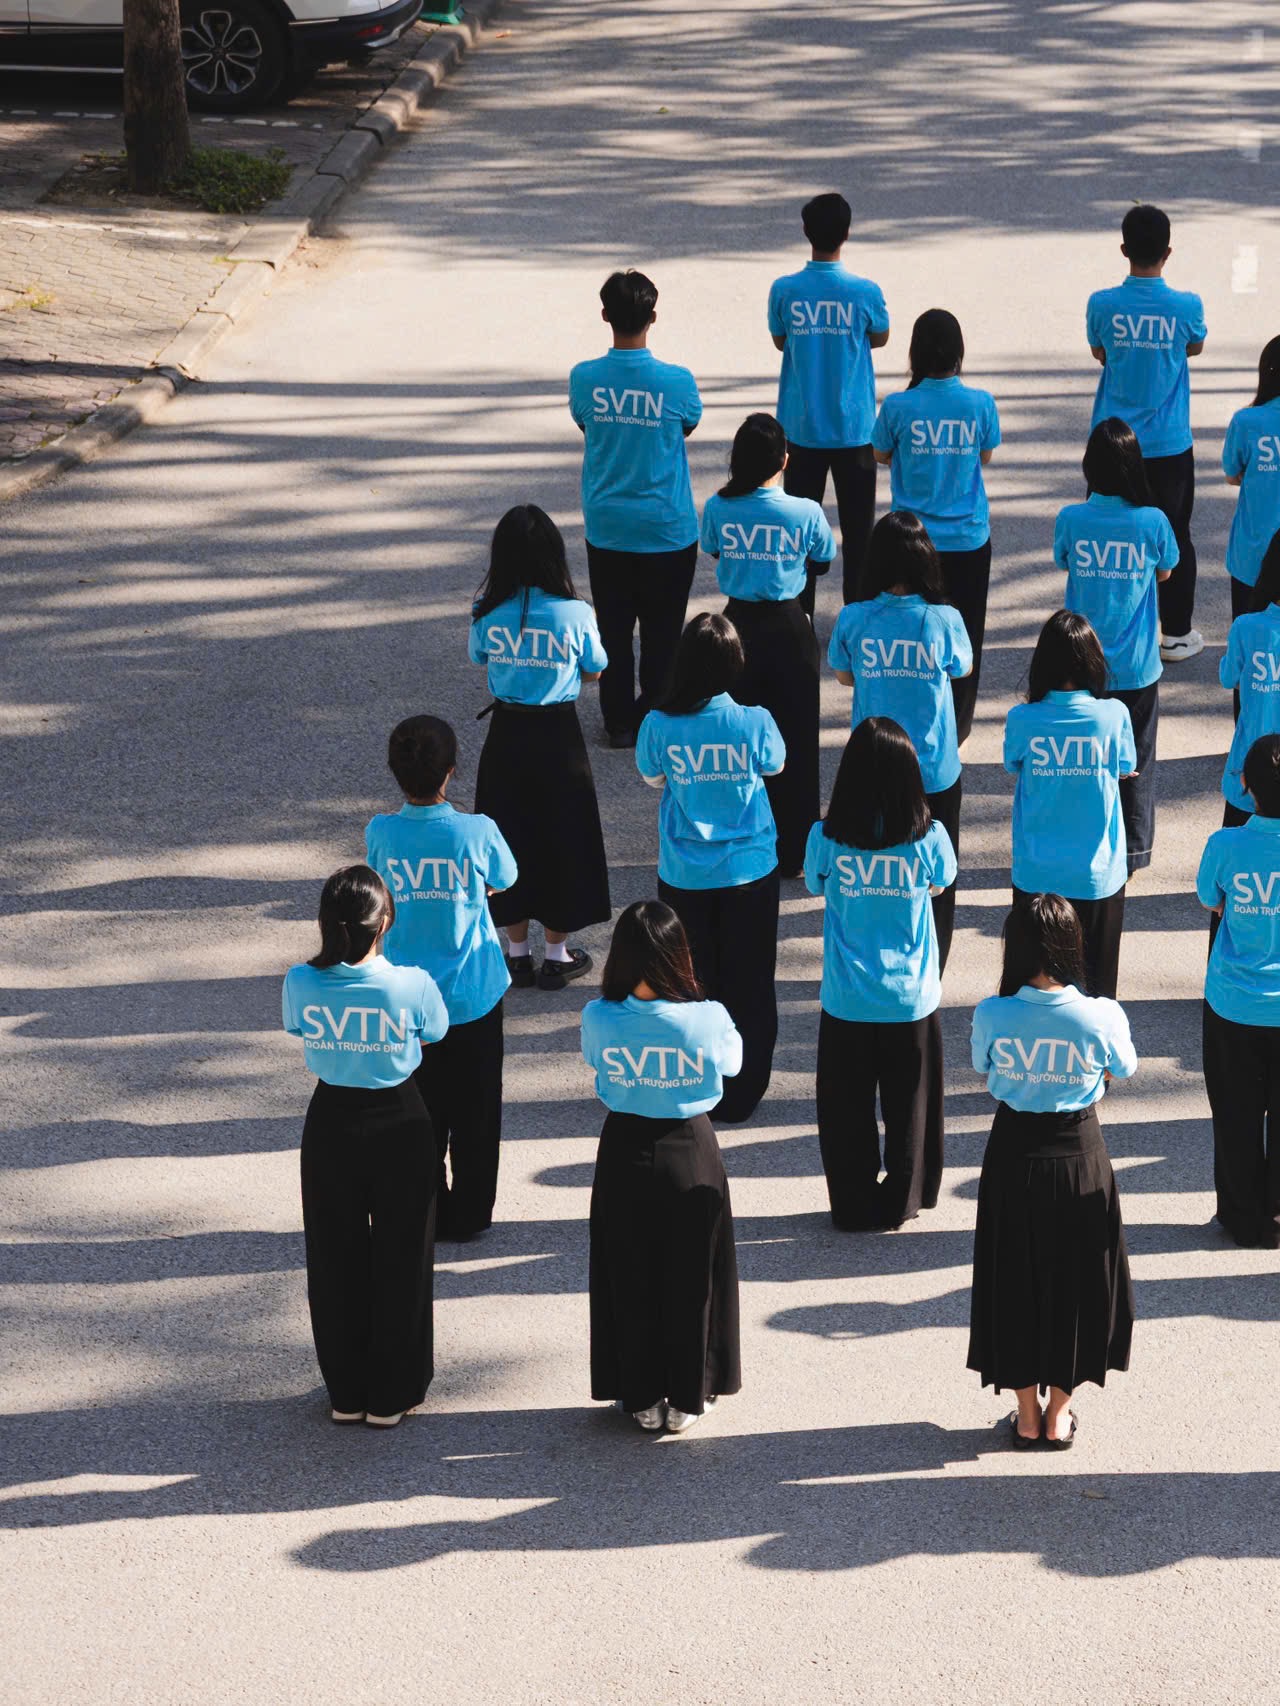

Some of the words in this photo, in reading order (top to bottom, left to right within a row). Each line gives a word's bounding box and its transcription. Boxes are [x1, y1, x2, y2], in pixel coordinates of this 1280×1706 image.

[790, 301, 852, 326] SVTN
[1112, 314, 1176, 341] SVTN
[592, 387, 663, 418] SVTN
[911, 420, 976, 446] SVTN
[721, 523, 801, 552] SVTN
[1075, 540, 1145, 569] SVTN
[488, 626, 569, 660] SVTN
[861, 639, 936, 670] SVTN
[667, 743, 747, 774] SVTN
[1030, 736, 1110, 766] SVTN
[386, 858, 469, 888] SVTN
[836, 855, 920, 887] SVTN
[304, 1005, 406, 1041] SVTN
[383, 1043, 405, 1053] ĐHV
[602, 1047, 704, 1078] SVTN
[995, 1038, 1095, 1073] SVTN
